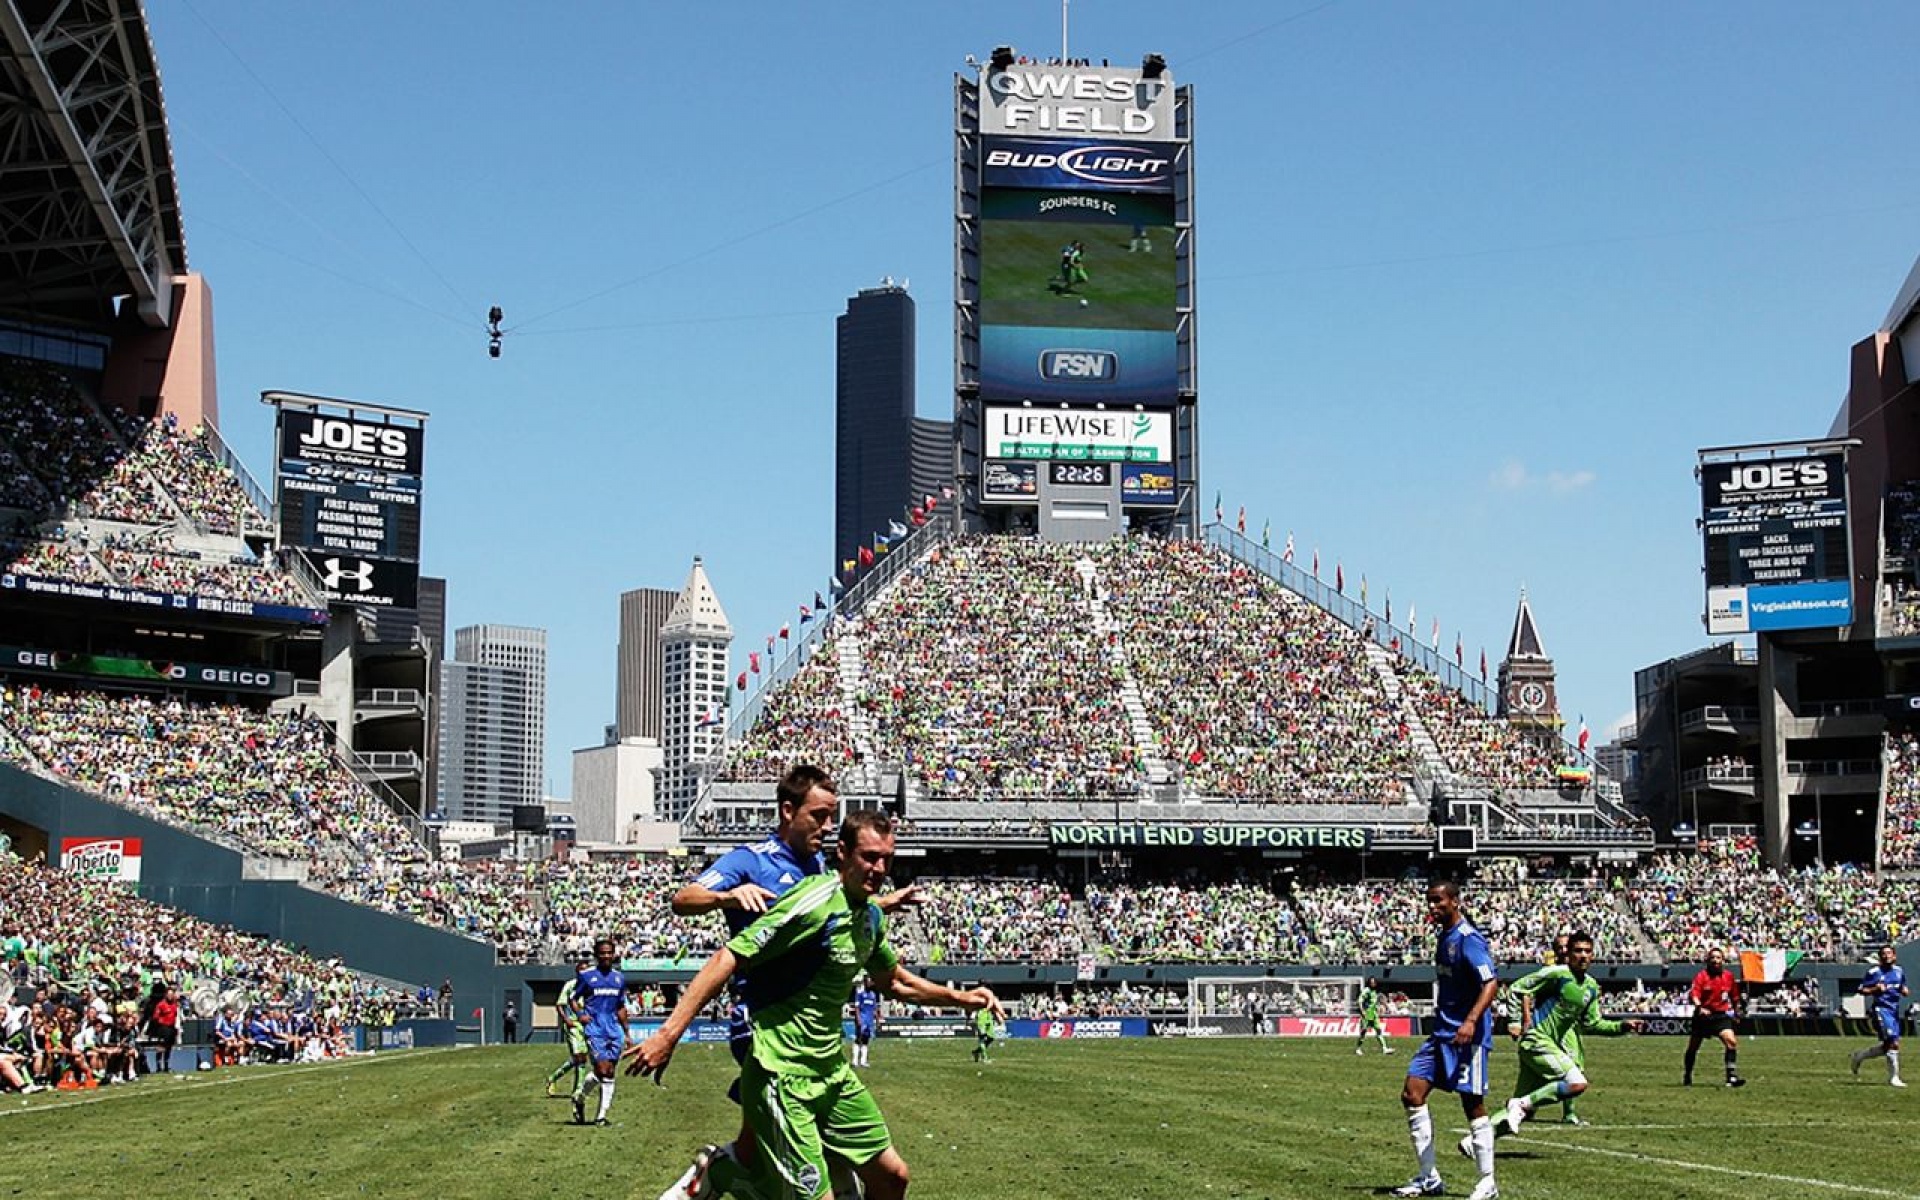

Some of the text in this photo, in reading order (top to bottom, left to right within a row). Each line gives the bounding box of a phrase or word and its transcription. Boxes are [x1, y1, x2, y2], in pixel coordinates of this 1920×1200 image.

[989, 71, 1166, 101] QWEST
[1003, 105, 1157, 134] FIELD
[986, 150, 1168, 173] BUD LIGHT
[1039, 195, 1117, 216] SOUNDERS FC
[1052, 353, 1105, 377] FSN
[300, 418, 408, 457] JOE'S
[1055, 465, 1104, 483] 22:26
[1719, 461, 1828, 491] JOE'S
[285, 479, 416, 505] SEAHAWKS VISITORS
[1727, 503, 1822, 518] DEFENSE
[1708, 517, 1842, 535] SEAHAWKS VISITORS
[1751, 597, 1849, 614] VirginiaMason.org
[202, 667, 271, 685] GEICO
[1051, 825, 1366, 848] NORTH END SUPPORTERS
[1074, 1020, 1121, 1030] SOCCER
[1646, 1019, 1687, 1033] XBOX
[1458, 1063, 1470, 1084] 3
